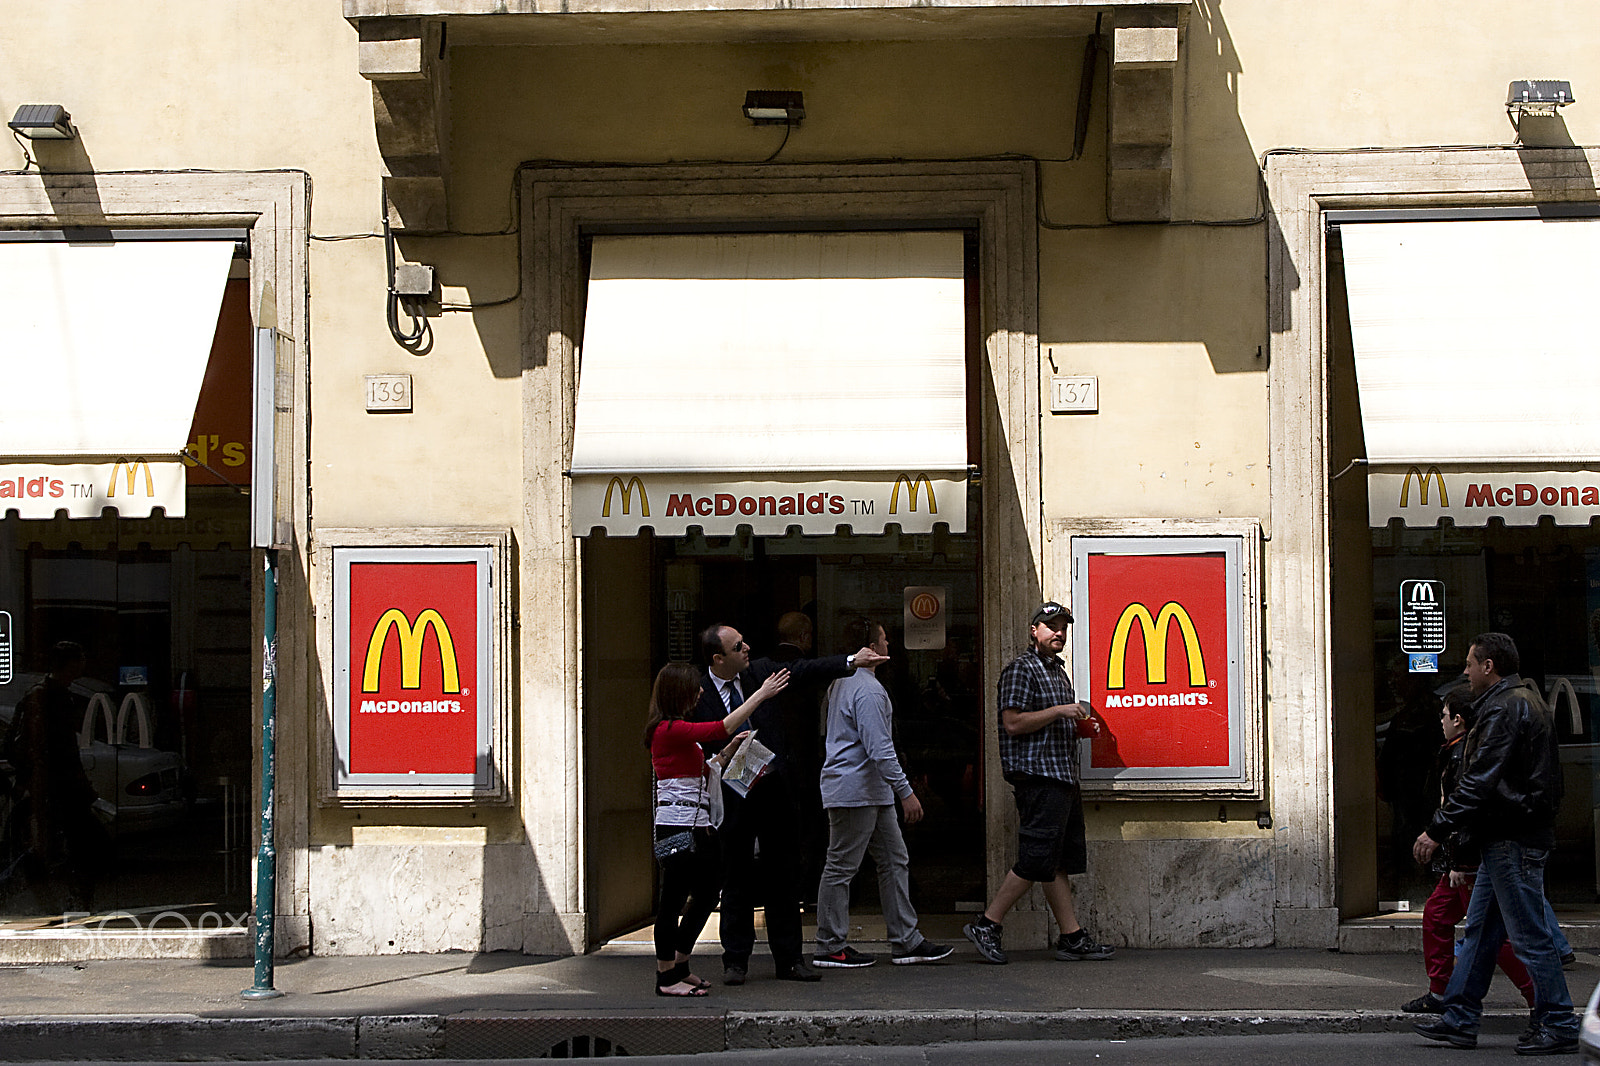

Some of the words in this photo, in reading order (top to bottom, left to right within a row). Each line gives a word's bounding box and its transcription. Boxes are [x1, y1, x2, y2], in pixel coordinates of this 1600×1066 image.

[371, 381, 405, 402] 139
[1057, 383, 1091, 404] 137
[0, 476, 65, 498] ald's
[70, 483, 93, 498] TM
[1465, 483, 1599, 507] McDona
[665, 492, 845, 517] McDonald's
[850, 499, 875, 515] TM
